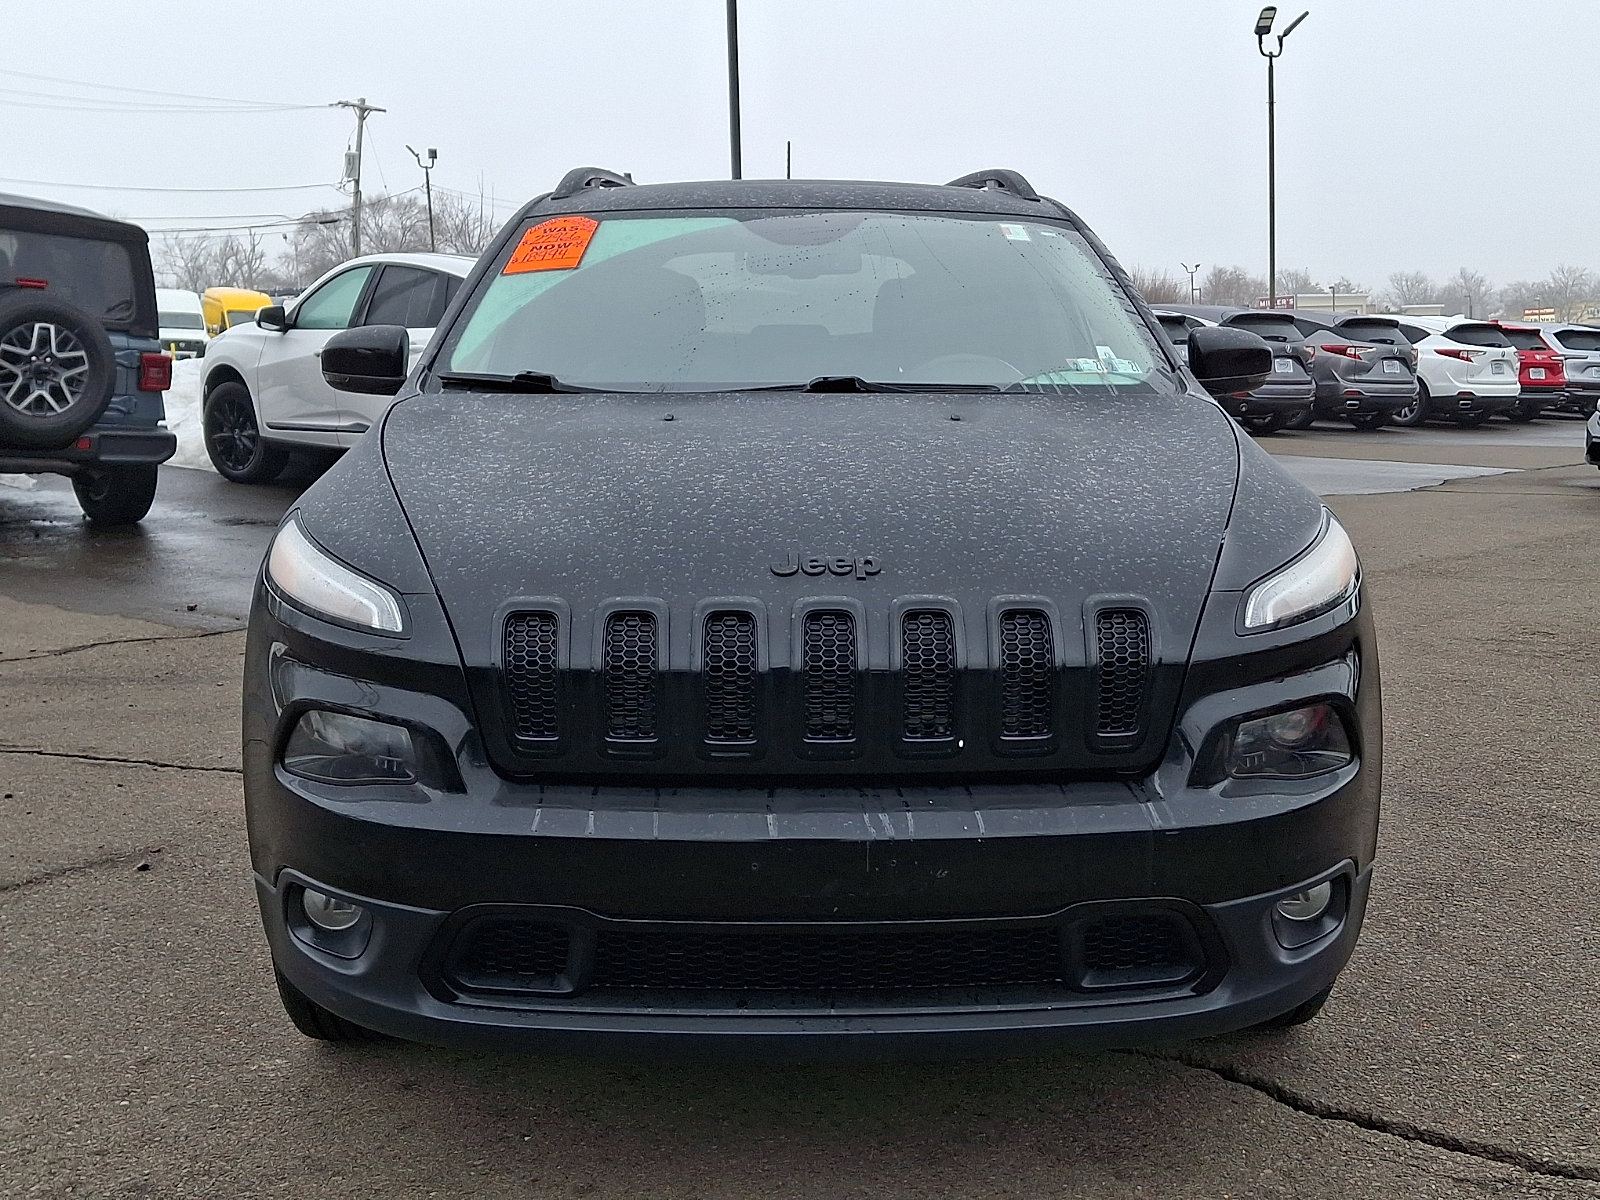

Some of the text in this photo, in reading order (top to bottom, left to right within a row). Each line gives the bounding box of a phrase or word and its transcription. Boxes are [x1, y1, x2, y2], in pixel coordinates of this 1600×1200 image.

[530, 242, 572, 252] NOW
[1260, 298, 1294, 307] MIER'S
[770, 551, 881, 580] Jeep
